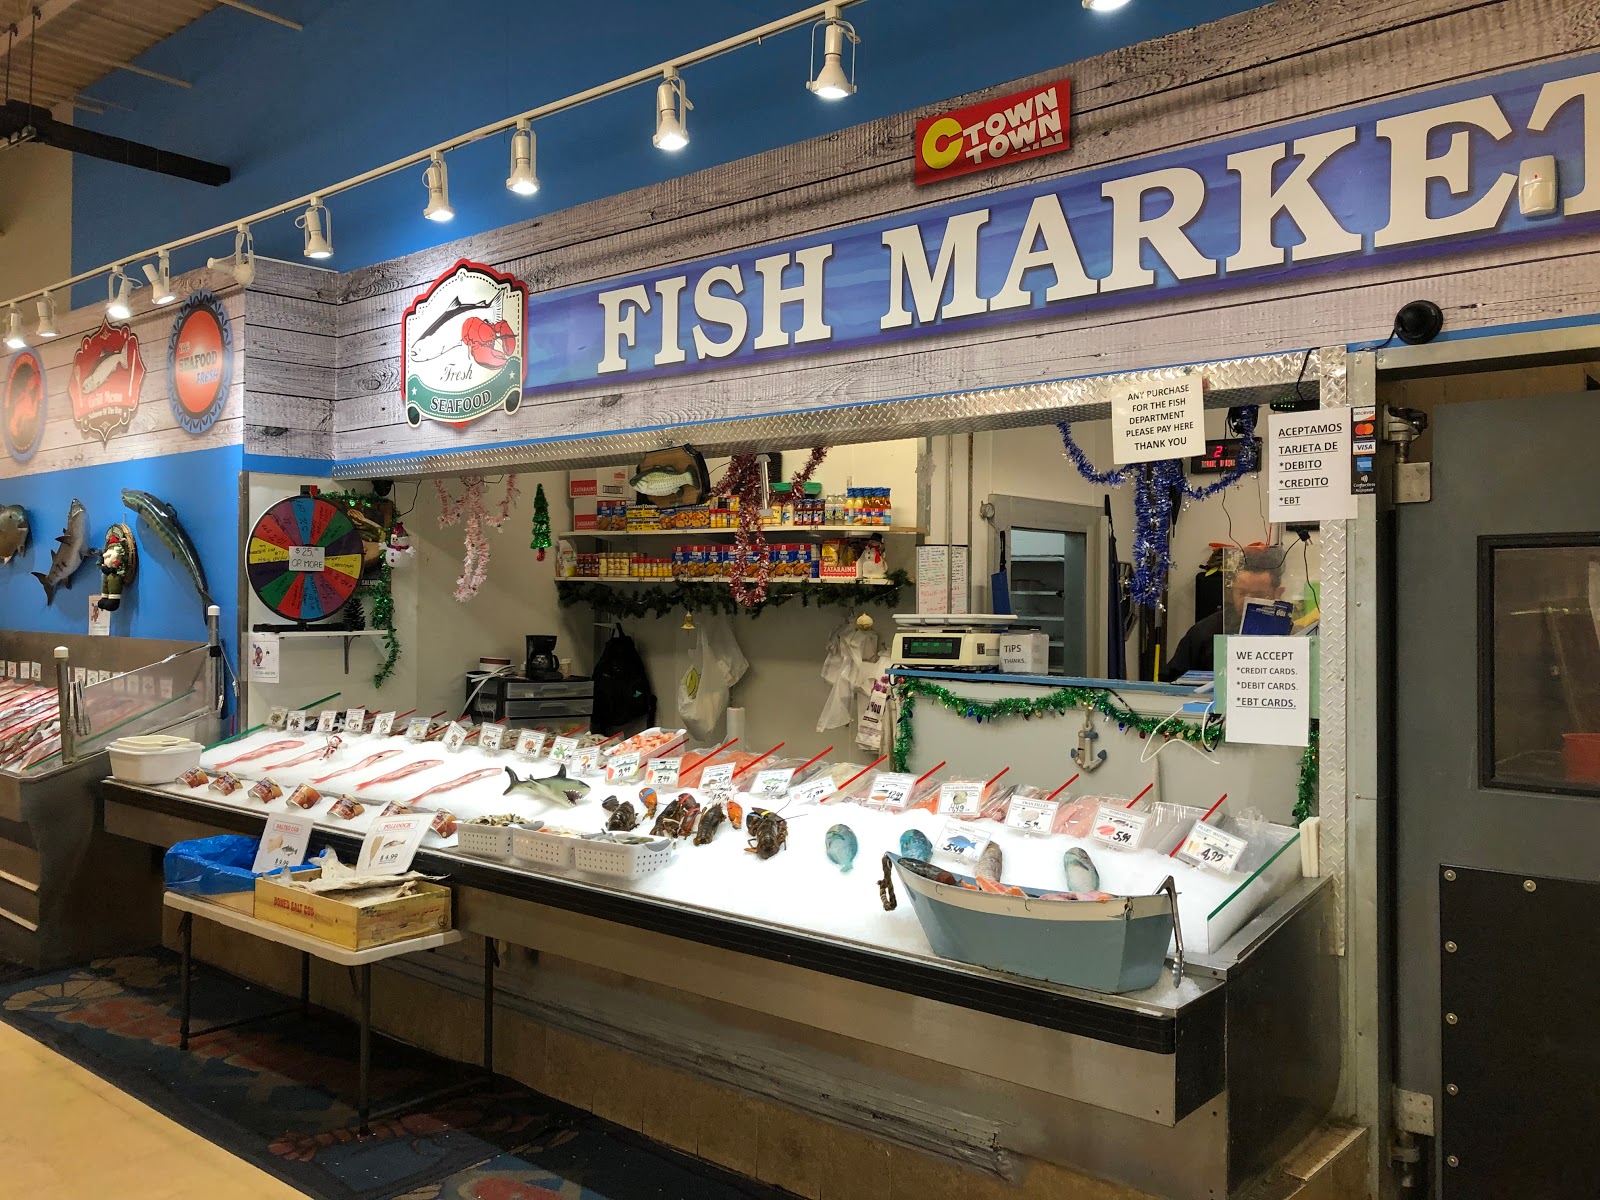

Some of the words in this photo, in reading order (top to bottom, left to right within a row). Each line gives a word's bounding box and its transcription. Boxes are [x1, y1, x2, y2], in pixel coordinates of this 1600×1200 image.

[962, 86, 1059, 144] TOWN
[966, 108, 1064, 166] TOWN
[597, 243, 832, 374] FISH
[179, 350, 218, 370] SEAFOOD
[197, 368, 219, 384] FRESH
[440, 363, 473, 382] Fresh
[1127, 391, 1144, 401] ANY
[1147, 384, 1190, 398] PURCHASE
[430, 390, 492, 413] SEAFOOD
[1132, 402, 1149, 412] FOR
[1150, 400, 1166, 410] THE
[1168, 398, 1186, 408] FISH
[1129, 410, 1185, 425] DEPARTMENT
[1126, 425, 1155, 437] PLEASE
[1157, 423, 1175, 434] PAY
[1176, 421, 1194, 431] HERE
[1278, 422, 1342, 437] ACEPTAMOS
[1134, 439, 1166, 451] THANK
[1167, 436, 1187, 446] YOU
[1278, 443, 1322, 455] TARJETA
[1324, 441, 1338, 451] DE
[1213, 445, 1223, 458] 2
[304, 560, 323, 568] MORE
[1004, 645, 1022, 653] TIPS
[1236, 651, 1253, 660] WE
[1255, 651, 1294, 661] ACCEPT
[1269, 667, 1298, 675] CARDS.
[1267, 682, 1299, 691] CARDS.
[1261, 698, 1297, 708] CARDS.
